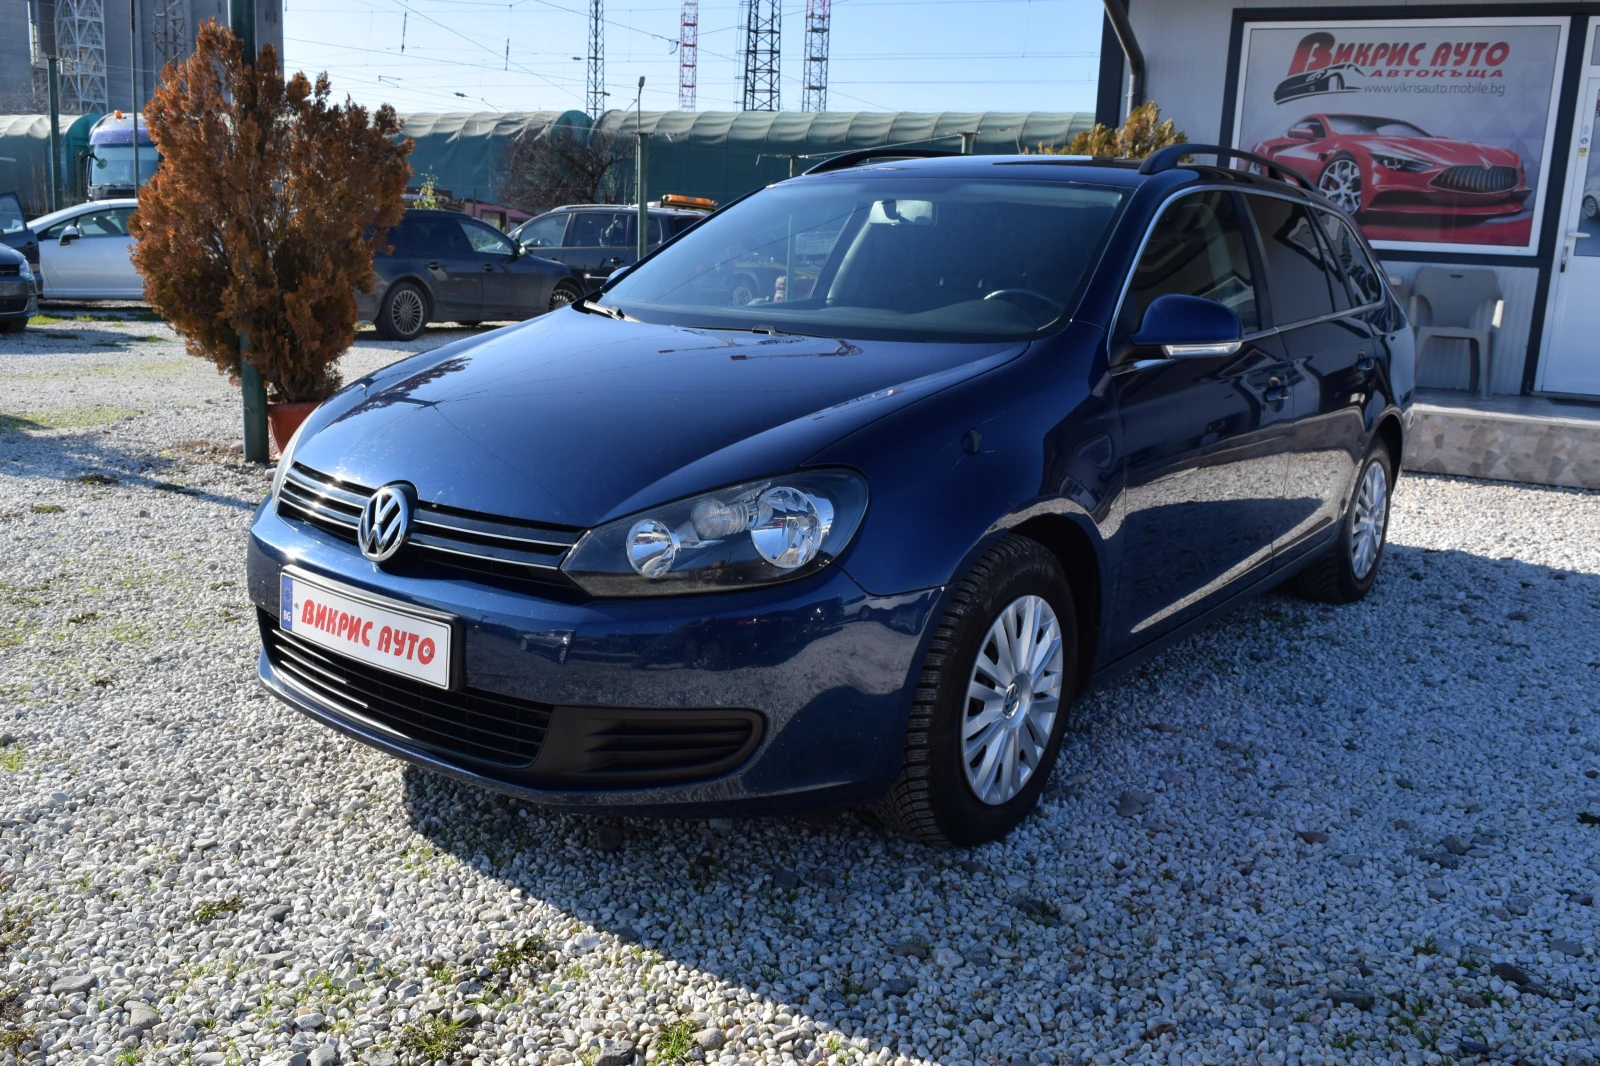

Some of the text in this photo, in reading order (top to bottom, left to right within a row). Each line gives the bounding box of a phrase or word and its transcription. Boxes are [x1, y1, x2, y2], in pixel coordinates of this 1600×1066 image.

[1287, 32, 1510, 77] ВИКРИС АУТО
[1369, 69, 1503, 78] АВТОКЪЩА
[1364, 83, 1506, 97] www.vikrisauto.mobile.bg
[283, 610, 291, 622] BG
[301, 599, 436, 665] ВИКРИС АУТО
